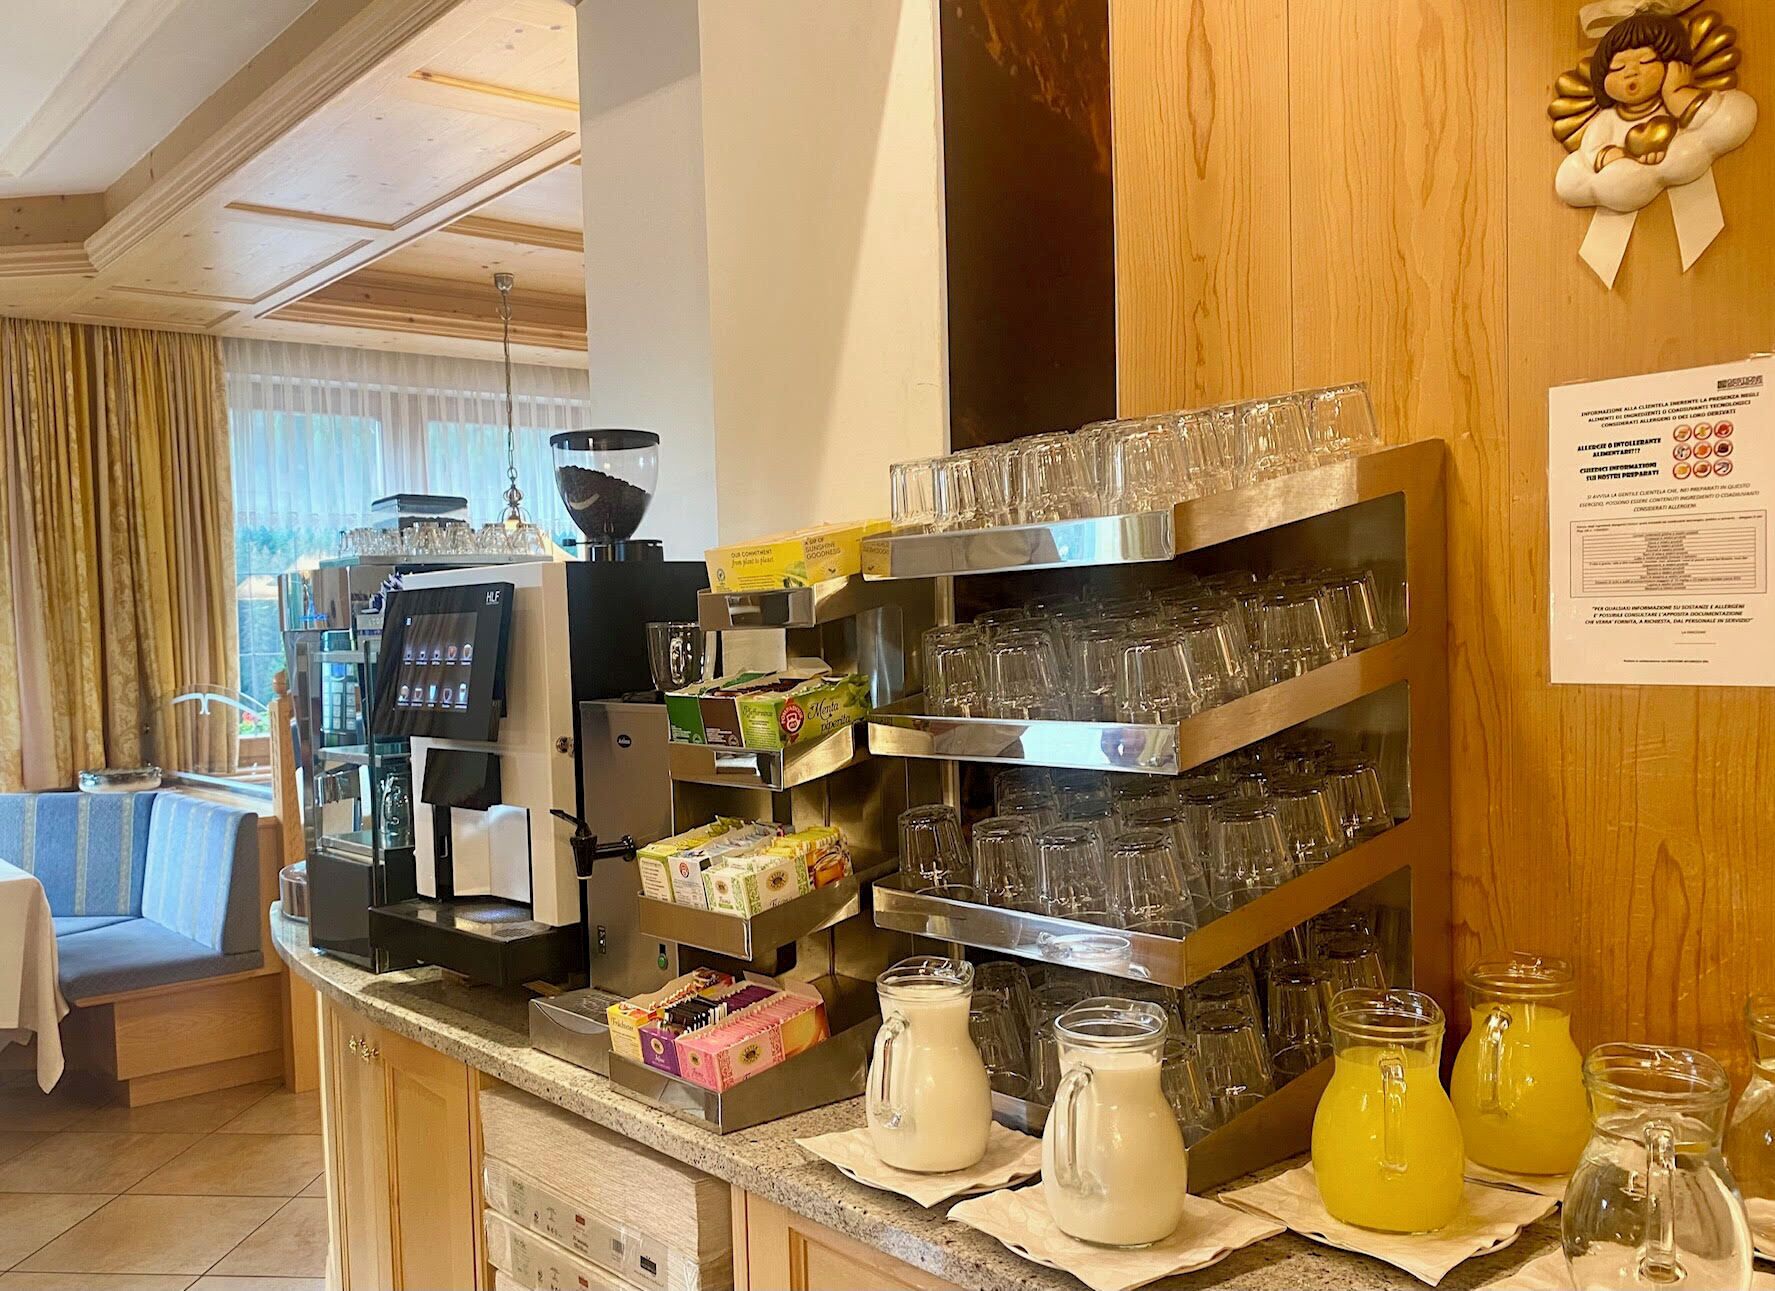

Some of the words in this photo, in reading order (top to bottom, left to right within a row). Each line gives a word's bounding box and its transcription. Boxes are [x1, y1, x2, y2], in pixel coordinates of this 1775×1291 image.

[1581, 408, 1622, 416] INFORMAZIONE
[1624, 410, 1660, 418] INGREDIENTI
[1710, 400, 1751, 408] TECNOLOGICI
[1622, 470, 1659, 478] PREPARATI
[806, 543, 835, 553] SUNSHINE
[806, 547, 841, 560] GOODNESS
[486, 591, 500, 602] HLF
[808, 698, 839, 720] Menta
